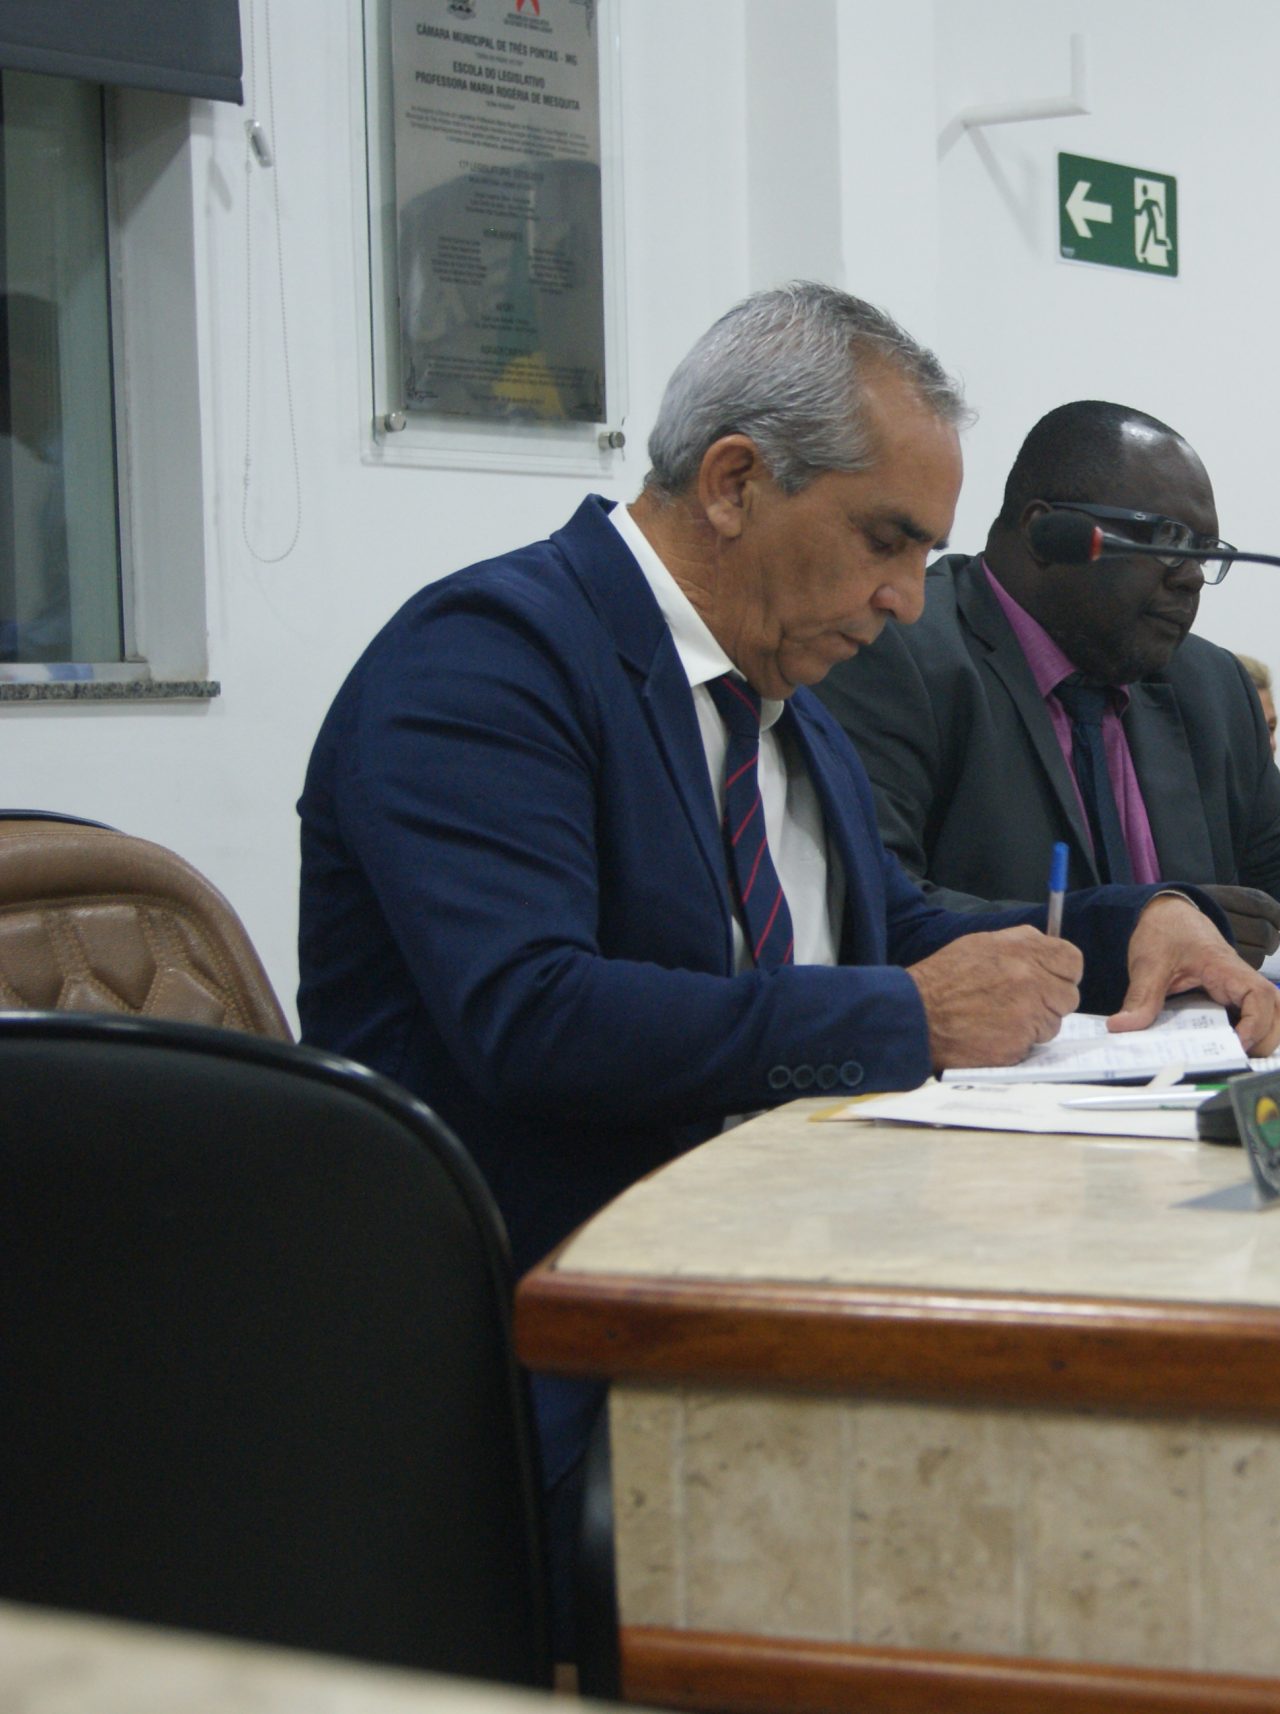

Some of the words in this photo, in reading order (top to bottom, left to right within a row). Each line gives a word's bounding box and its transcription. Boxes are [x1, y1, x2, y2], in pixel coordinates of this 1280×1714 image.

[416, 22, 450, 40] CÂMARA
[453, 31, 495, 51] MUNICIPAL
[497, 41, 509, 52] DE
[509, 41, 529, 57] TRÊS
[530, 47, 559, 63] PONTAS
[565, 54, 578, 66] MG
[415, 70, 468, 91] PROFESSORA
[470, 81, 494, 95] MARIA
[496, 85, 530, 102] ROGÉRIA
[531, 92, 542, 105] DE
[543, 94, 580, 111] MESQUITA
[453, 61, 483, 76] ESCOLA
[485, 67, 497, 80] DO
[498, 69, 546, 89] LEGISLATIVO
